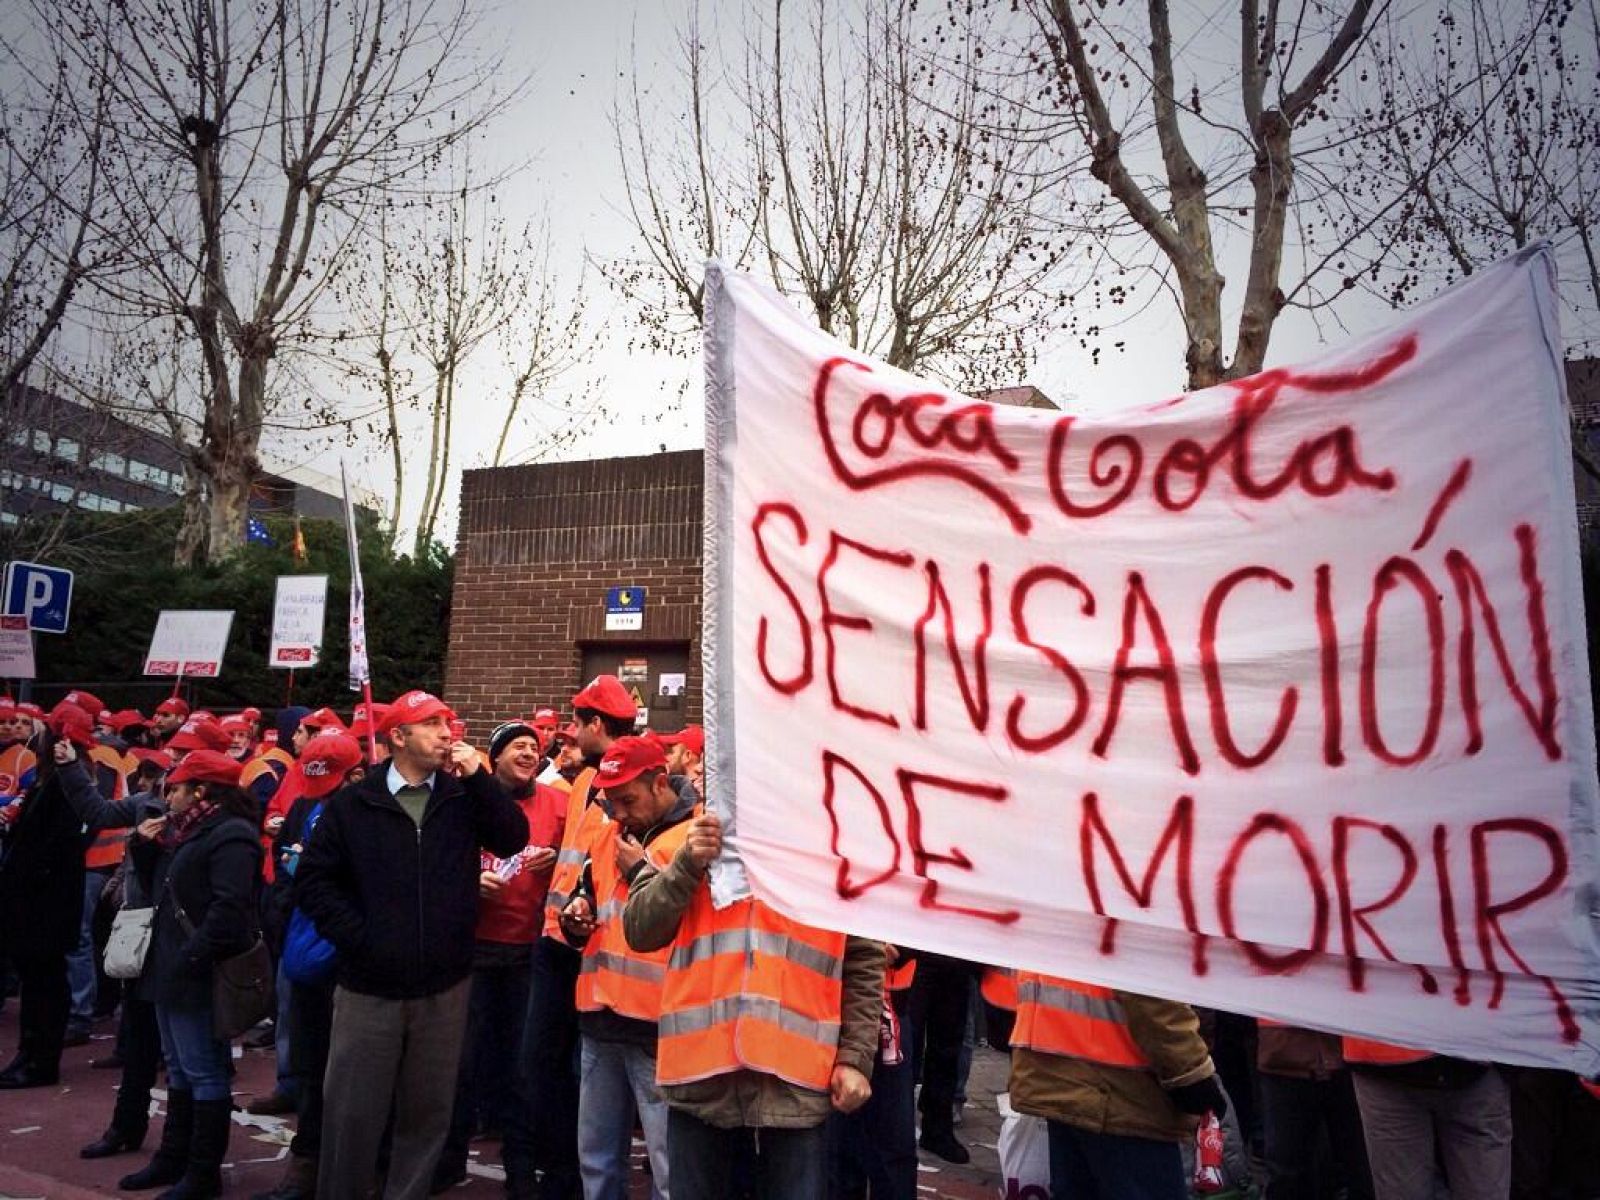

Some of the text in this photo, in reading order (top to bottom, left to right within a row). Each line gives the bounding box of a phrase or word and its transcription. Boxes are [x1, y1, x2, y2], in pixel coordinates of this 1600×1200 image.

[810, 336, 1420, 536] Coca Cola
[25, 571, 53, 622] P
[750, 460, 1562, 774] SENSACIÓN
[820, 748, 1022, 926] DE
[1078, 790, 1582, 1044] MORIR
